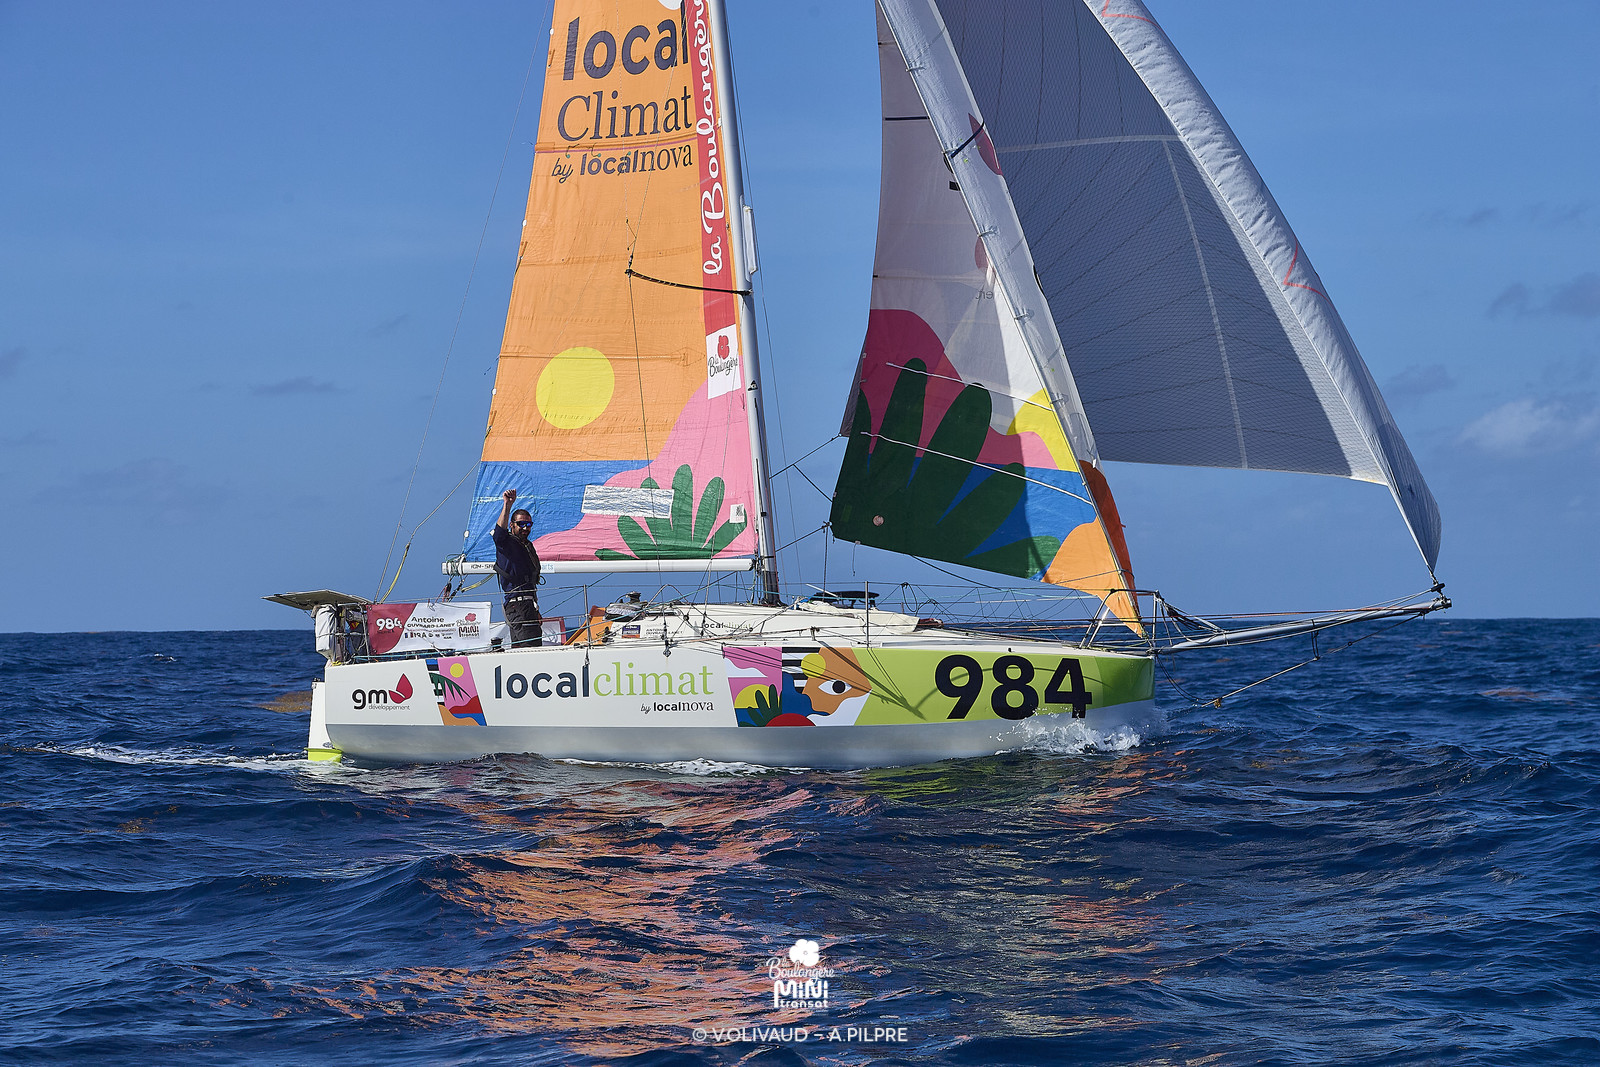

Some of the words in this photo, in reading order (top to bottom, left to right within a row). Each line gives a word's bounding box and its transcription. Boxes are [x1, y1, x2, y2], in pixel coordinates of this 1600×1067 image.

[563, 0, 689, 80] local
[557, 86, 692, 141] Climat
[693, 0, 725, 234] Boulangèr
[551, 157, 573, 183] by
[703, 236, 722, 275] la
[376, 617, 402, 630] 984
[352, 689, 387, 710] gm
[935, 654, 1092, 720] 984
[641, 703, 651, 713] by
